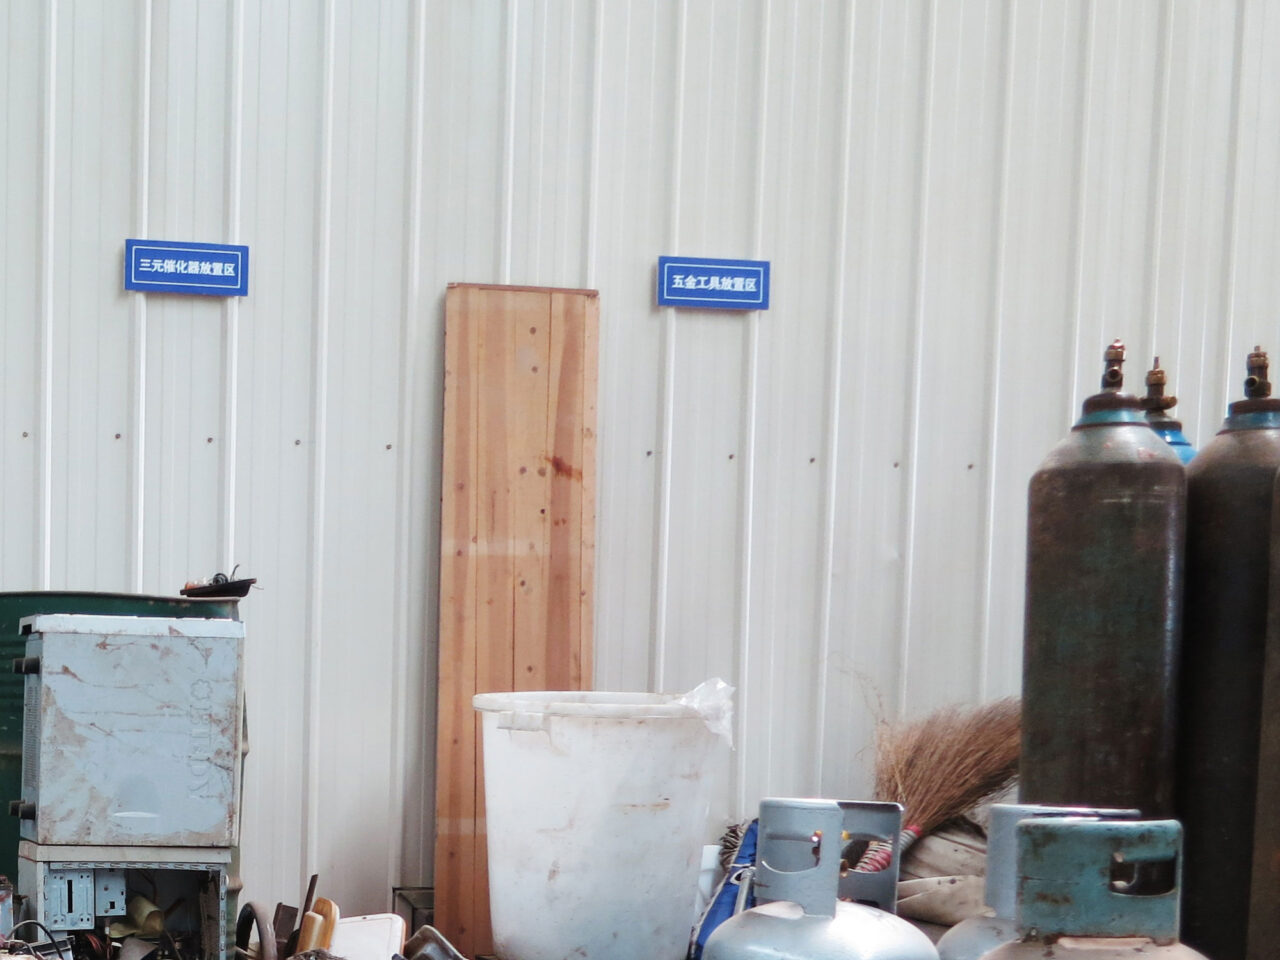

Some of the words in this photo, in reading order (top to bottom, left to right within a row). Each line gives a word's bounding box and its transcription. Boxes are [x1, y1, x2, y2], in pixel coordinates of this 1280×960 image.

[139, 258, 236, 276] 三元催化器放置区
[671, 274, 758, 292] 五金工具放置区
